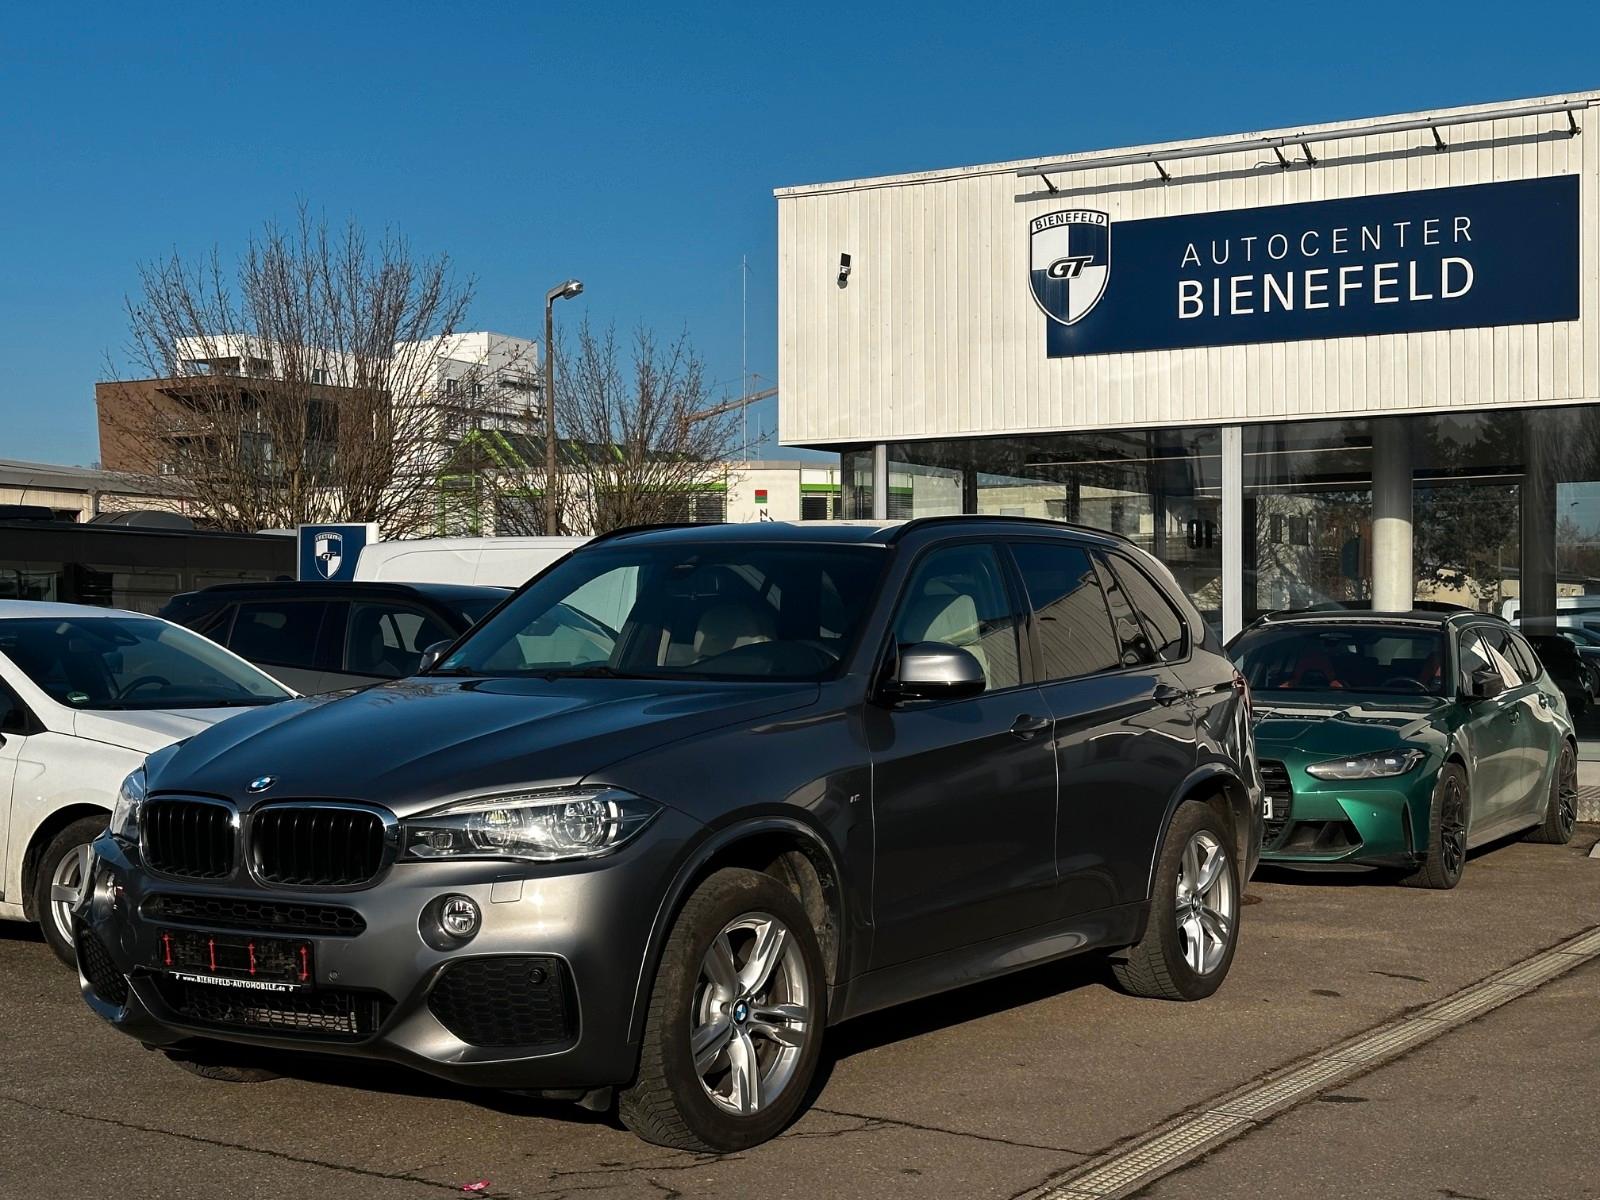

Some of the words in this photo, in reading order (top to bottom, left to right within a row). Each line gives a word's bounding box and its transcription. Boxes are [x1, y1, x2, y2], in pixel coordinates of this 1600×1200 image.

[1035, 212, 1105, 230] BIENEFELD
[1180, 216, 1472, 268] AUTOCENTER
[1047, 256, 1094, 279] GT
[1178, 256, 1475, 319] BIENEFELD
